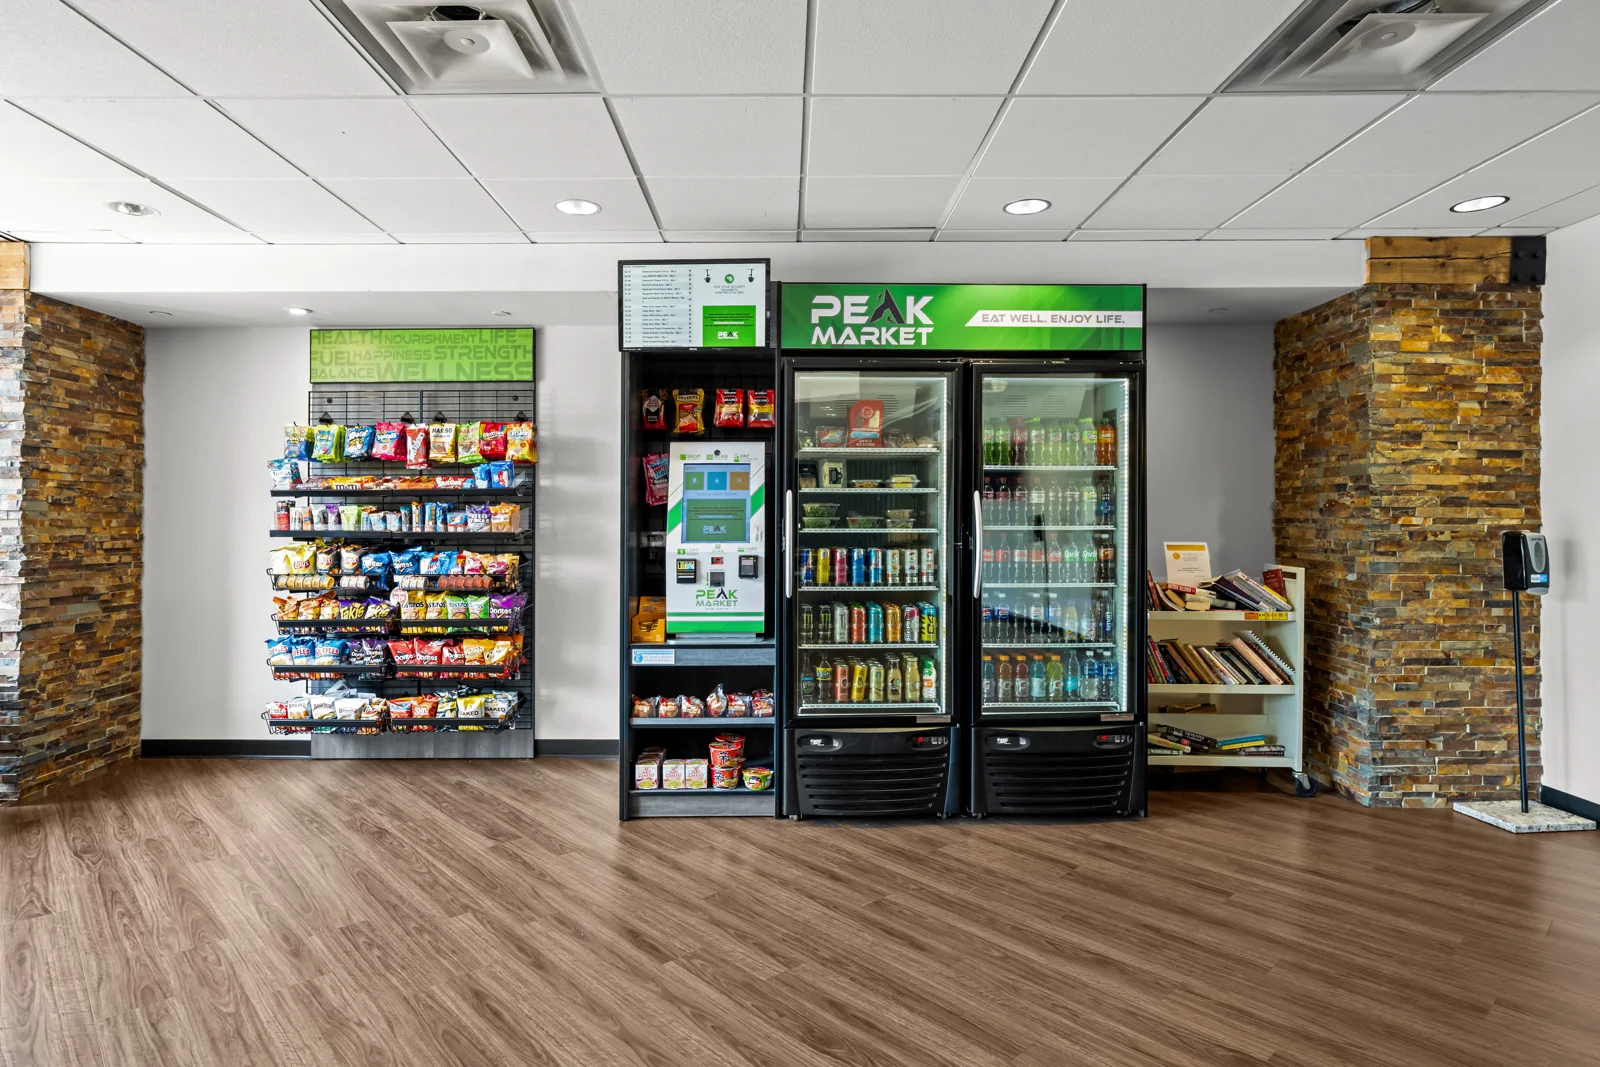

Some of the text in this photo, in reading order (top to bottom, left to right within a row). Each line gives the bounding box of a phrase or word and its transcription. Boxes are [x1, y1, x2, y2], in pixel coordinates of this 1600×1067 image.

[811, 288, 934, 325] PEAK
[982, 313, 1125, 324] EAT WELL. ENJOY LIFE.
[383, 334, 477, 345] NOURISHMENT
[478, 329, 517, 344] LIFE
[811, 326, 934, 346] MARKET
[353, 349, 431, 361] HAPPINESS
[433, 345, 533, 360] STRENGTH
[375, 361, 533, 381] WELLNESS
[696, 587, 738, 600] PEAK
